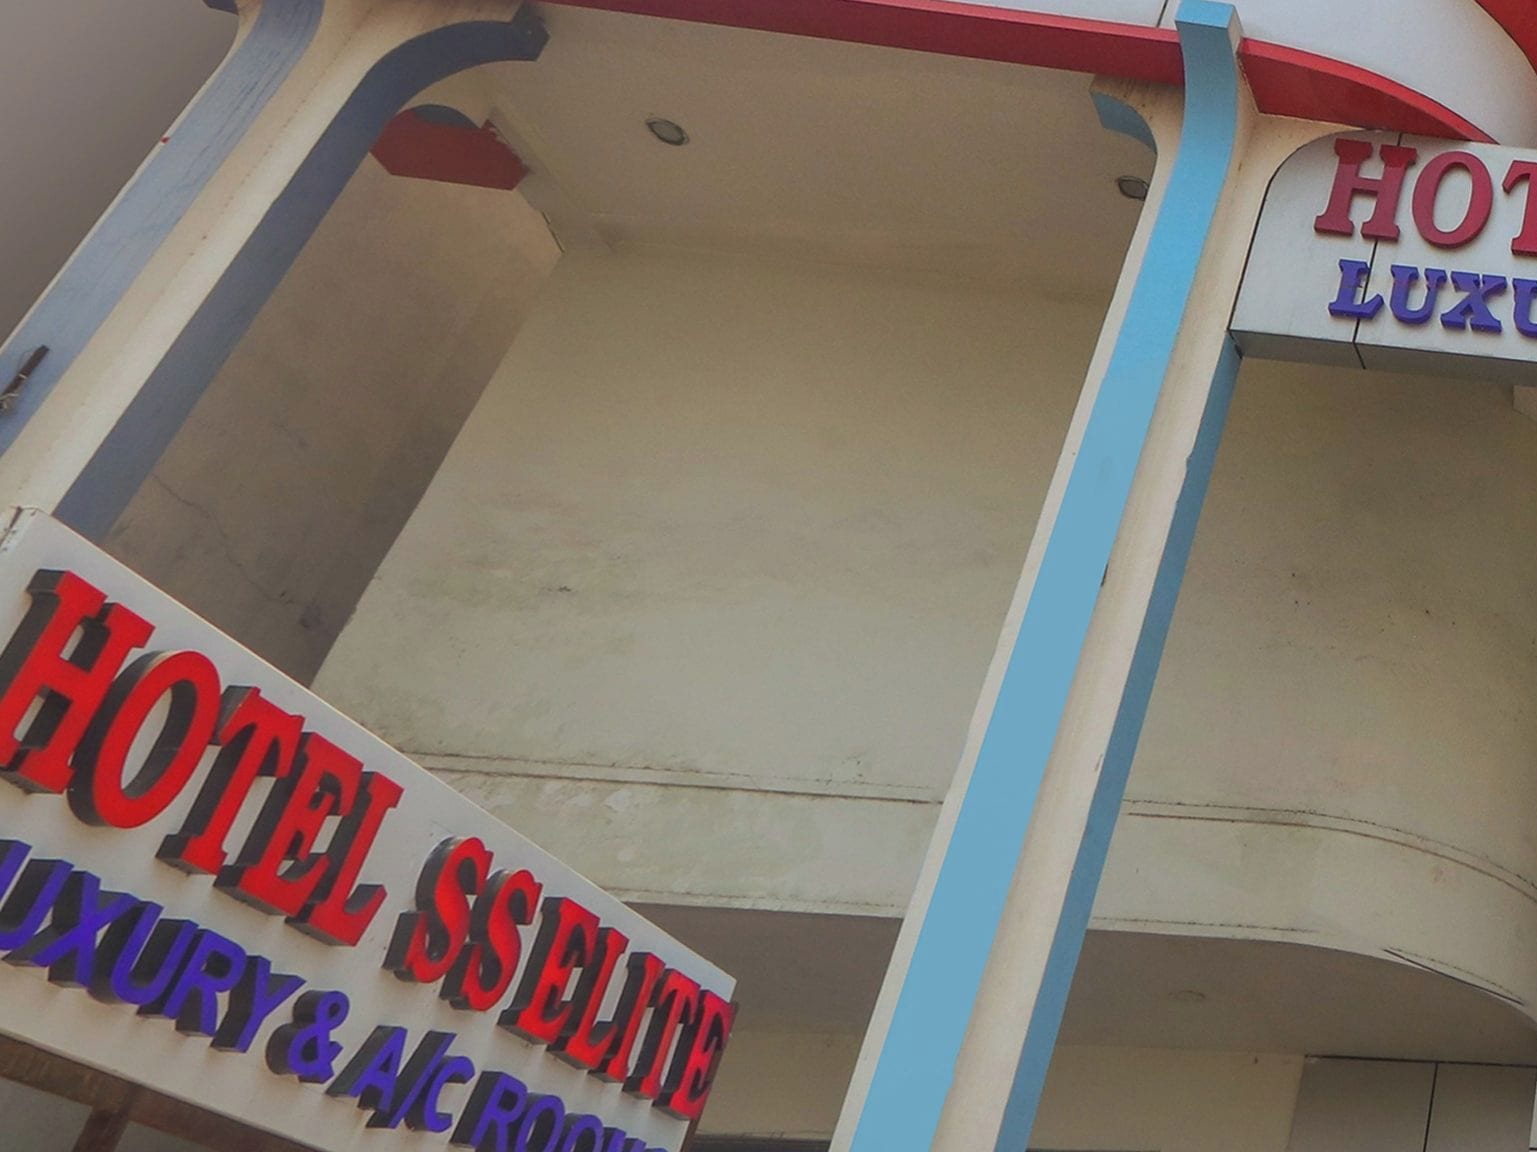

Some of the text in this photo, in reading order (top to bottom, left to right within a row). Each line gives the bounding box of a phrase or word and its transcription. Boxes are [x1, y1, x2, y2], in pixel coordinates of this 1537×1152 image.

[0, 569, 404, 947] HOTEL
[265, 990, 351, 1084] &
[326, 1025, 476, 1132] A/C
[450, 1071, 670, 1152] ROO
